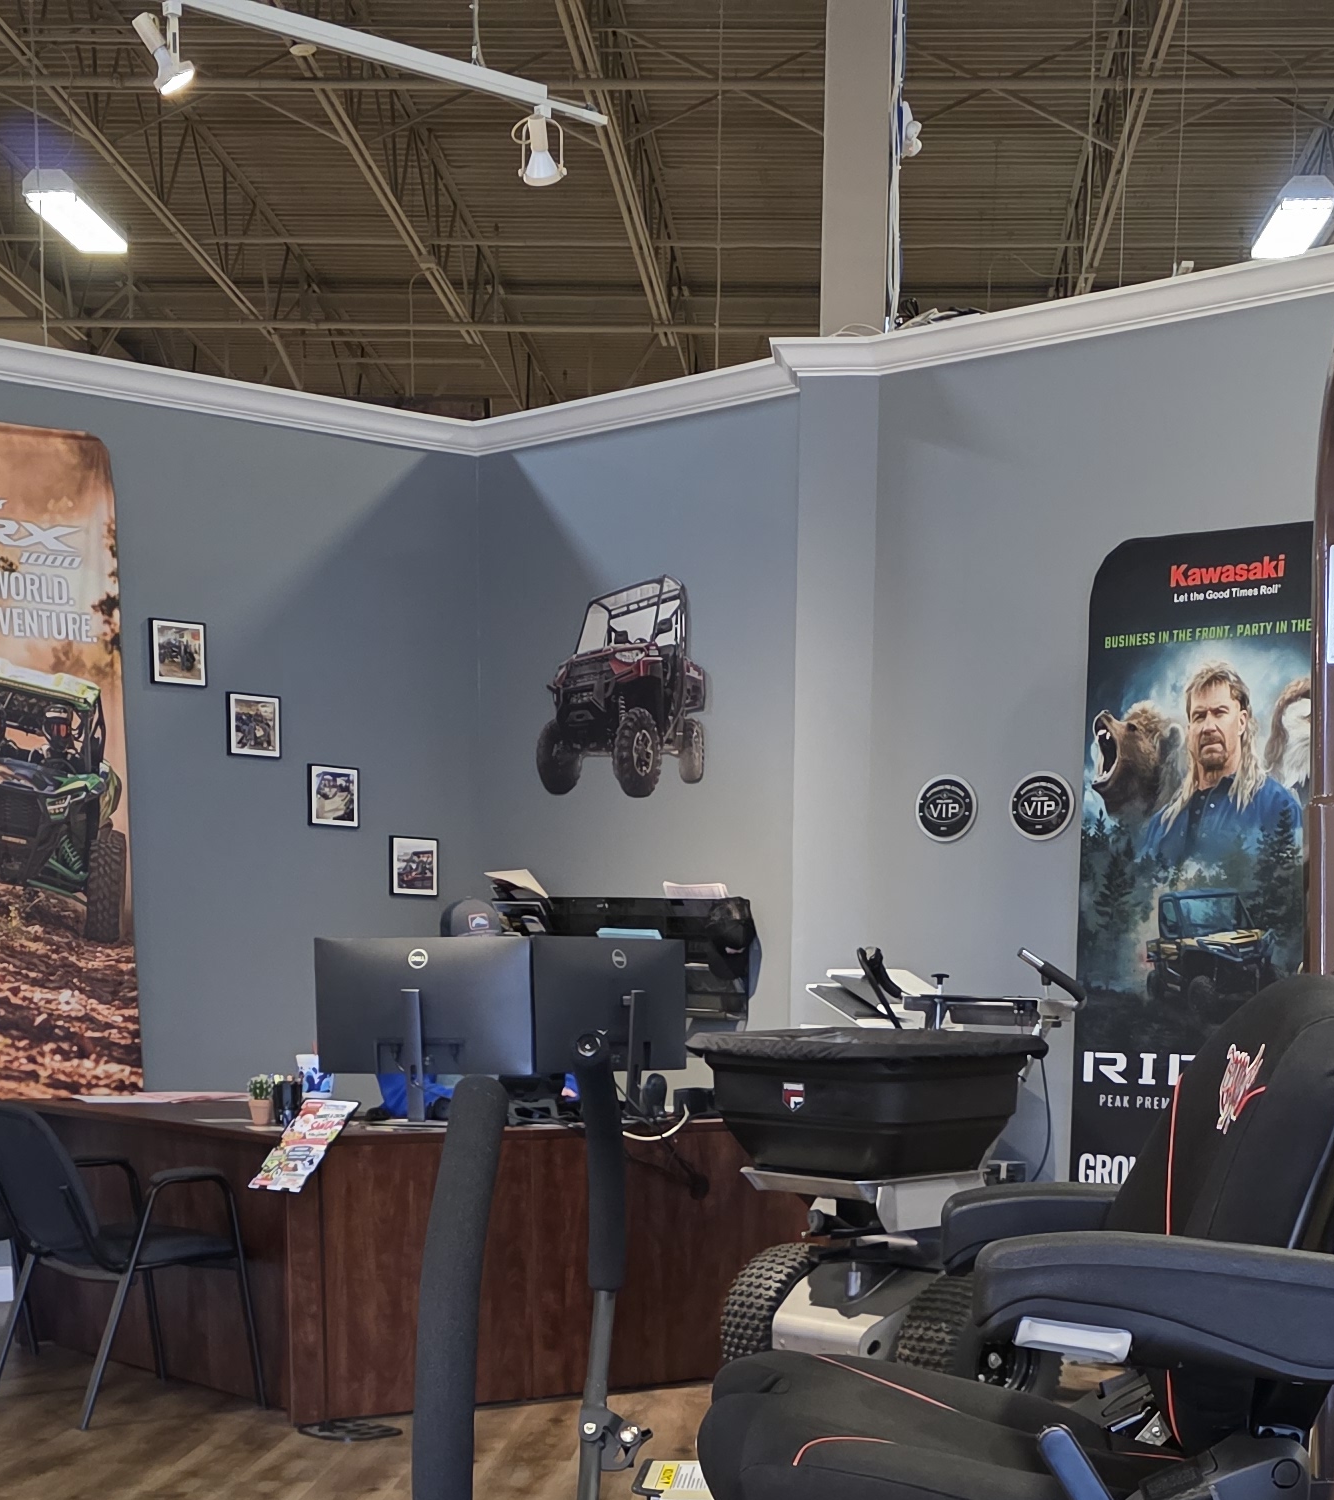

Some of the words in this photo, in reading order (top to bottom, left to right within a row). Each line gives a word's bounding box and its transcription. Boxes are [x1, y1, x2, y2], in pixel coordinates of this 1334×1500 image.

[20, 552, 82, 568] 1000
[1170, 554, 1285, 587] Kawasaki
[1174, 592, 1188, 603] Let
[1190, 591, 1204, 602] the
[1206, 589, 1229, 600] Good
[1231, 587, 1258, 598] Times
[1104, 632, 1155, 649] BUSINESS
[1158, 631, 1169, 643] IN
[1172, 629, 1193, 642] THE
[1195, 625, 1234, 641] FRONT.
[1237, 622, 1272, 637] PARTY
[1276, 620, 1287, 634] IN
[1291, 618, 1312, 632] THE
[930, 803, 959, 818] VIP
[1024, 800, 1056, 815] VIP
[1099, 1094, 1130, 1108] PEAK
